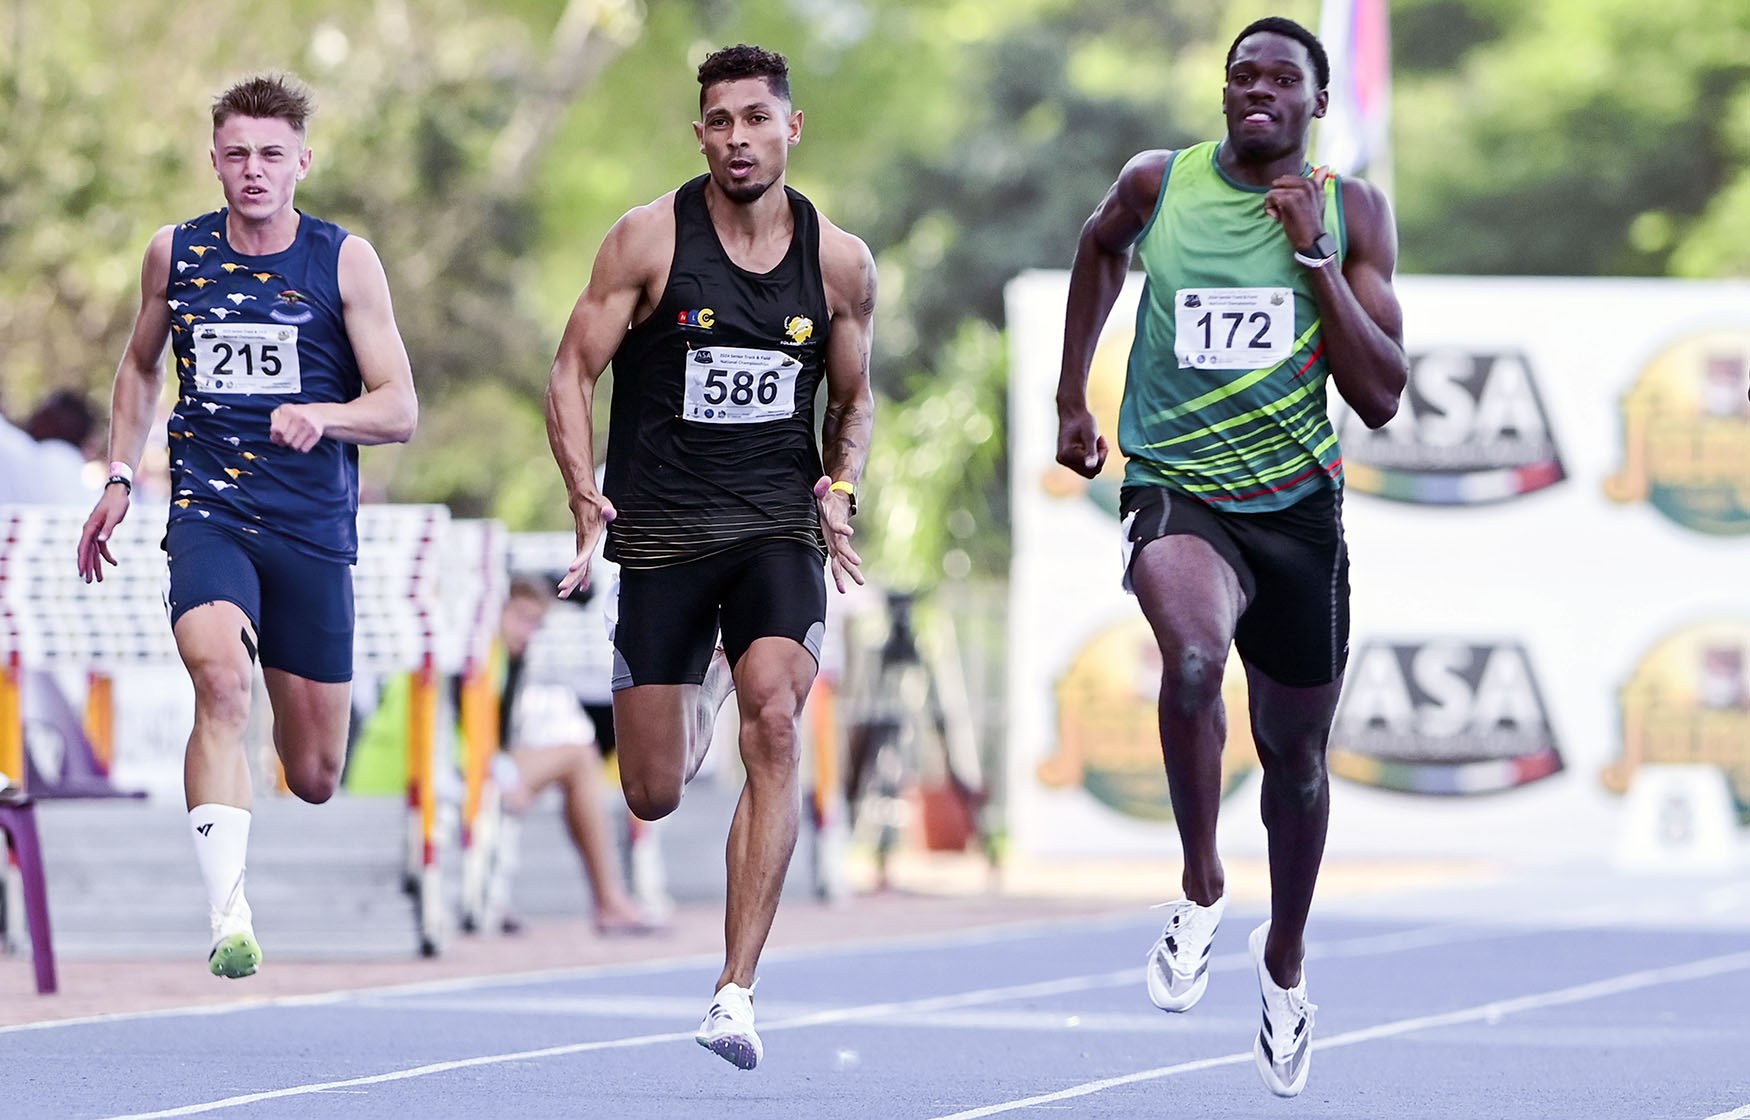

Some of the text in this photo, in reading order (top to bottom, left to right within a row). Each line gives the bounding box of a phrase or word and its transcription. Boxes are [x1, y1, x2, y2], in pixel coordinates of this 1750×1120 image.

[1196, 311, 1272, 350] 172
[212, 342, 282, 377] 215
[697, 351, 712, 359] ASA
[703, 368, 780, 406] 586
[1338, 643, 1545, 738] ASA
